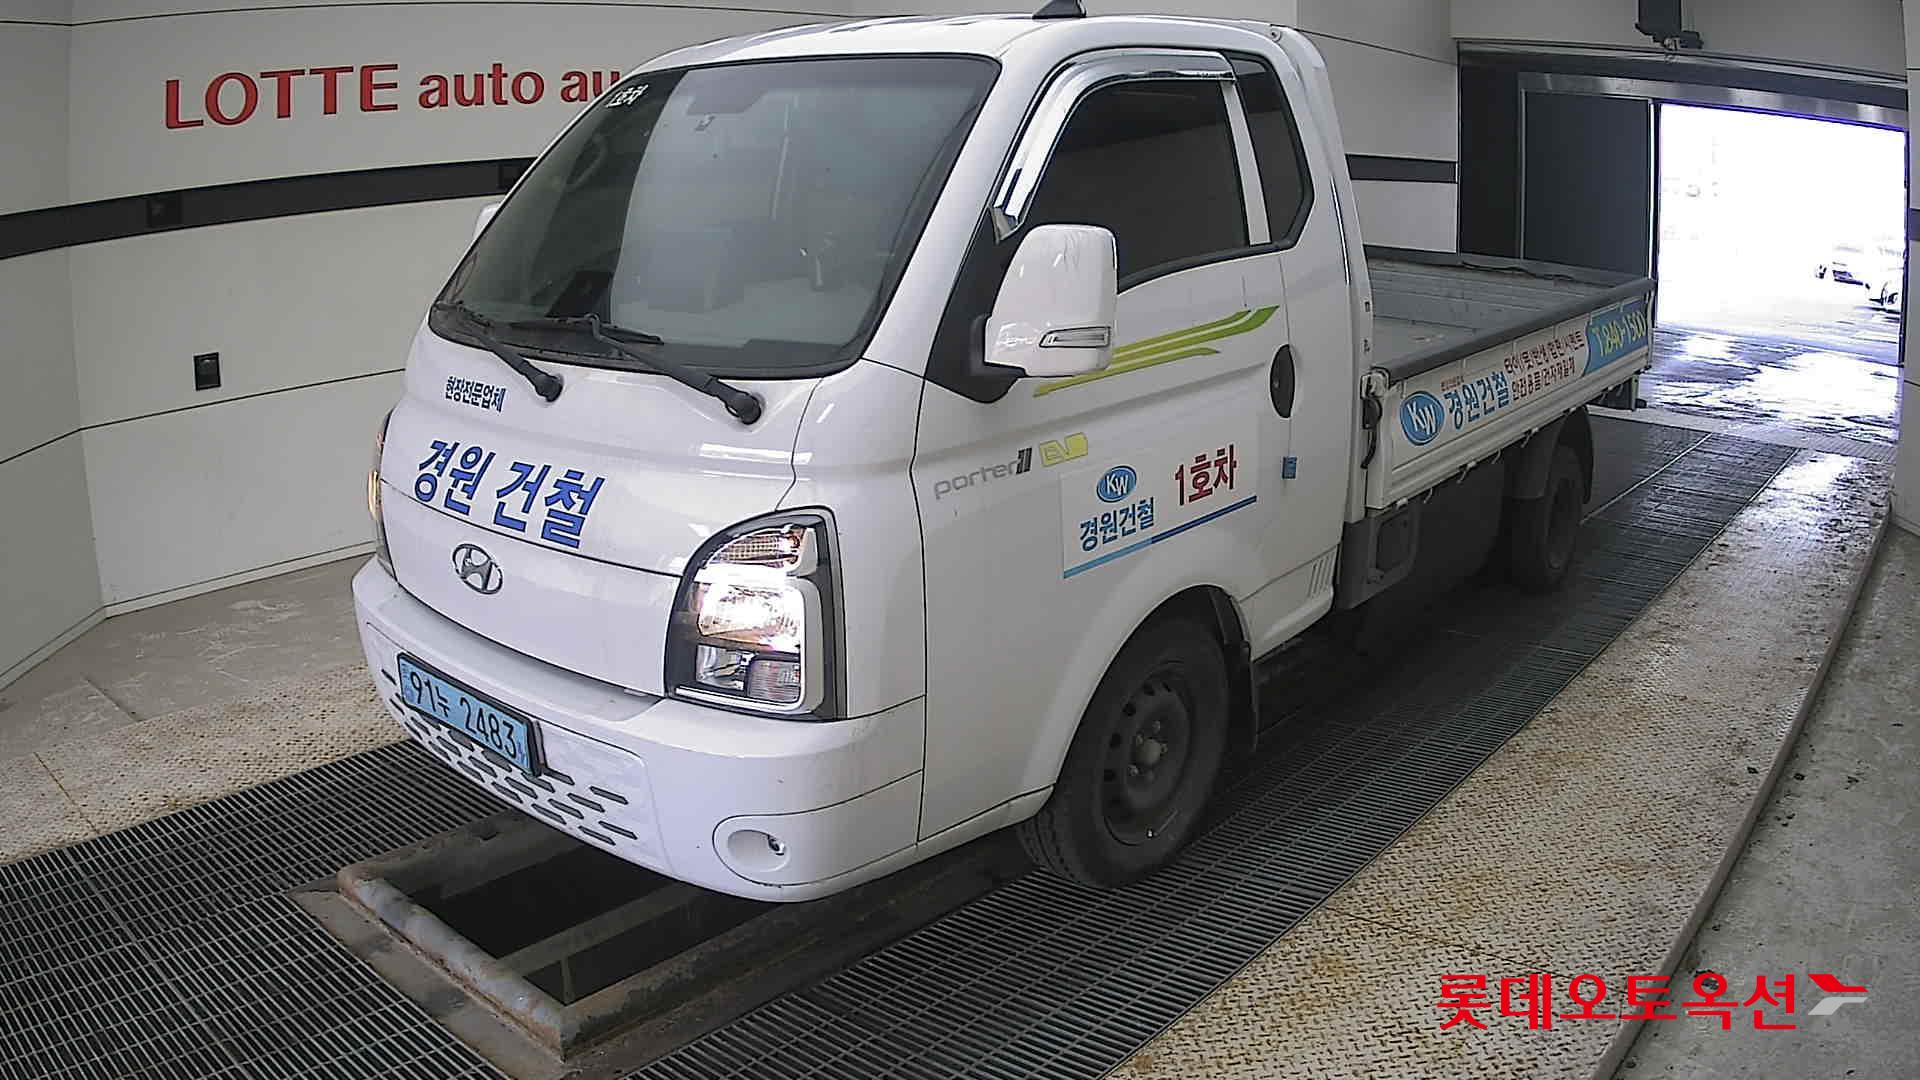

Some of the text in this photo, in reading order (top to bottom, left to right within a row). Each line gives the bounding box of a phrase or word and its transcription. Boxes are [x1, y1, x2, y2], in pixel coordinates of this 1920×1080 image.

[165, 63, 399, 129] LOTTE
[418, 63, 545, 109] auto
[446, 376, 507, 412] 현장전문업체
[1408, 401, 1437, 435] KW
[1443, 371, 1510, 430] 경원건철
[415, 440, 606, 549] 경원 건철
[1104, 468, 1130, 496] KW
[1174, 444, 1238, 506] 1호차
[1079, 497, 1155, 551] 경원건철
[410, 671, 518, 760] 91누 2483
